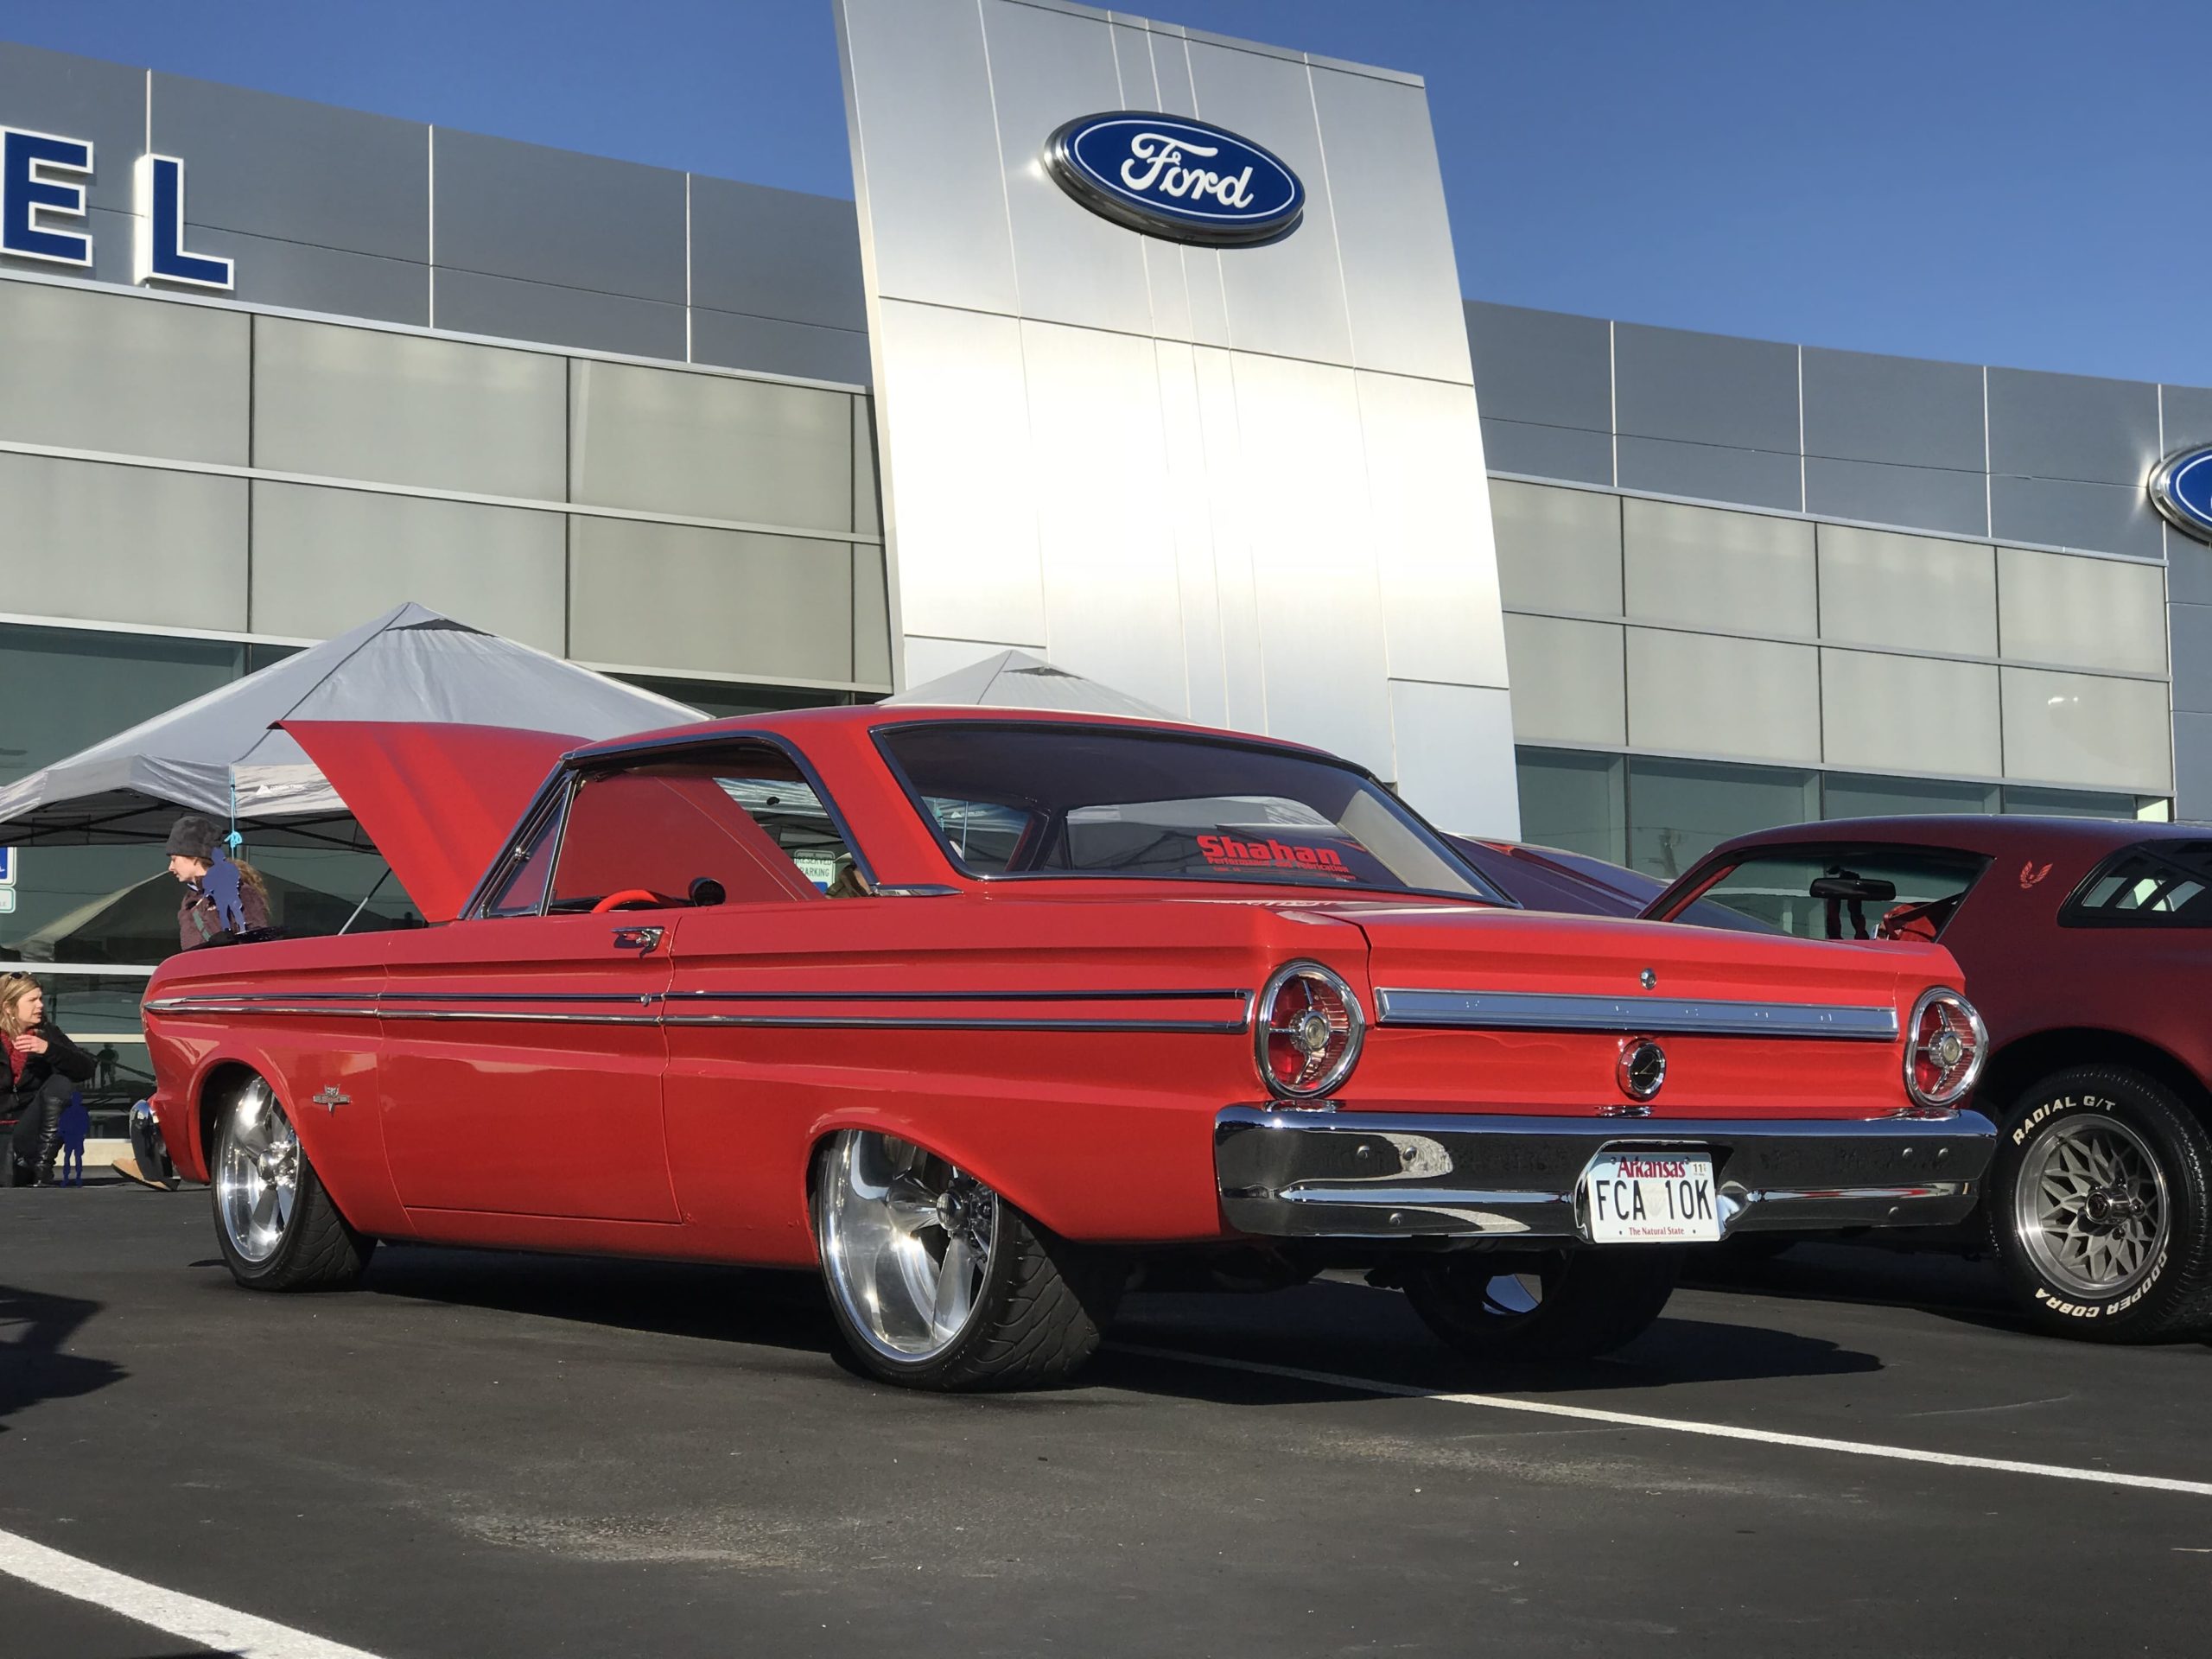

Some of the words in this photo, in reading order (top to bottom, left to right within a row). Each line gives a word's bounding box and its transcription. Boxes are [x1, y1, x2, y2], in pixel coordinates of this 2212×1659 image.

[1121, 133, 1254, 208] Ford
[797, 855, 831, 866] RESERVED
[1197, 836, 1341, 866] Shahan
[801, 868, 830, 877] PARKING
[2012, 1096, 2076, 1146] RADIAL
[2083, 1095, 2116, 1111] G/T
[1618, 1157, 1686, 1178] Arkansas
[1596, 1180, 1646, 1220] FCA
[1629, 1227, 1641, 1236] The
[1642, 1227, 1667, 1236] Natural
[1667, 1226, 1685, 1236] State
[2106, 1250, 2168, 1315] COOPER
[2035, 1287, 2100, 1319] COBRA
